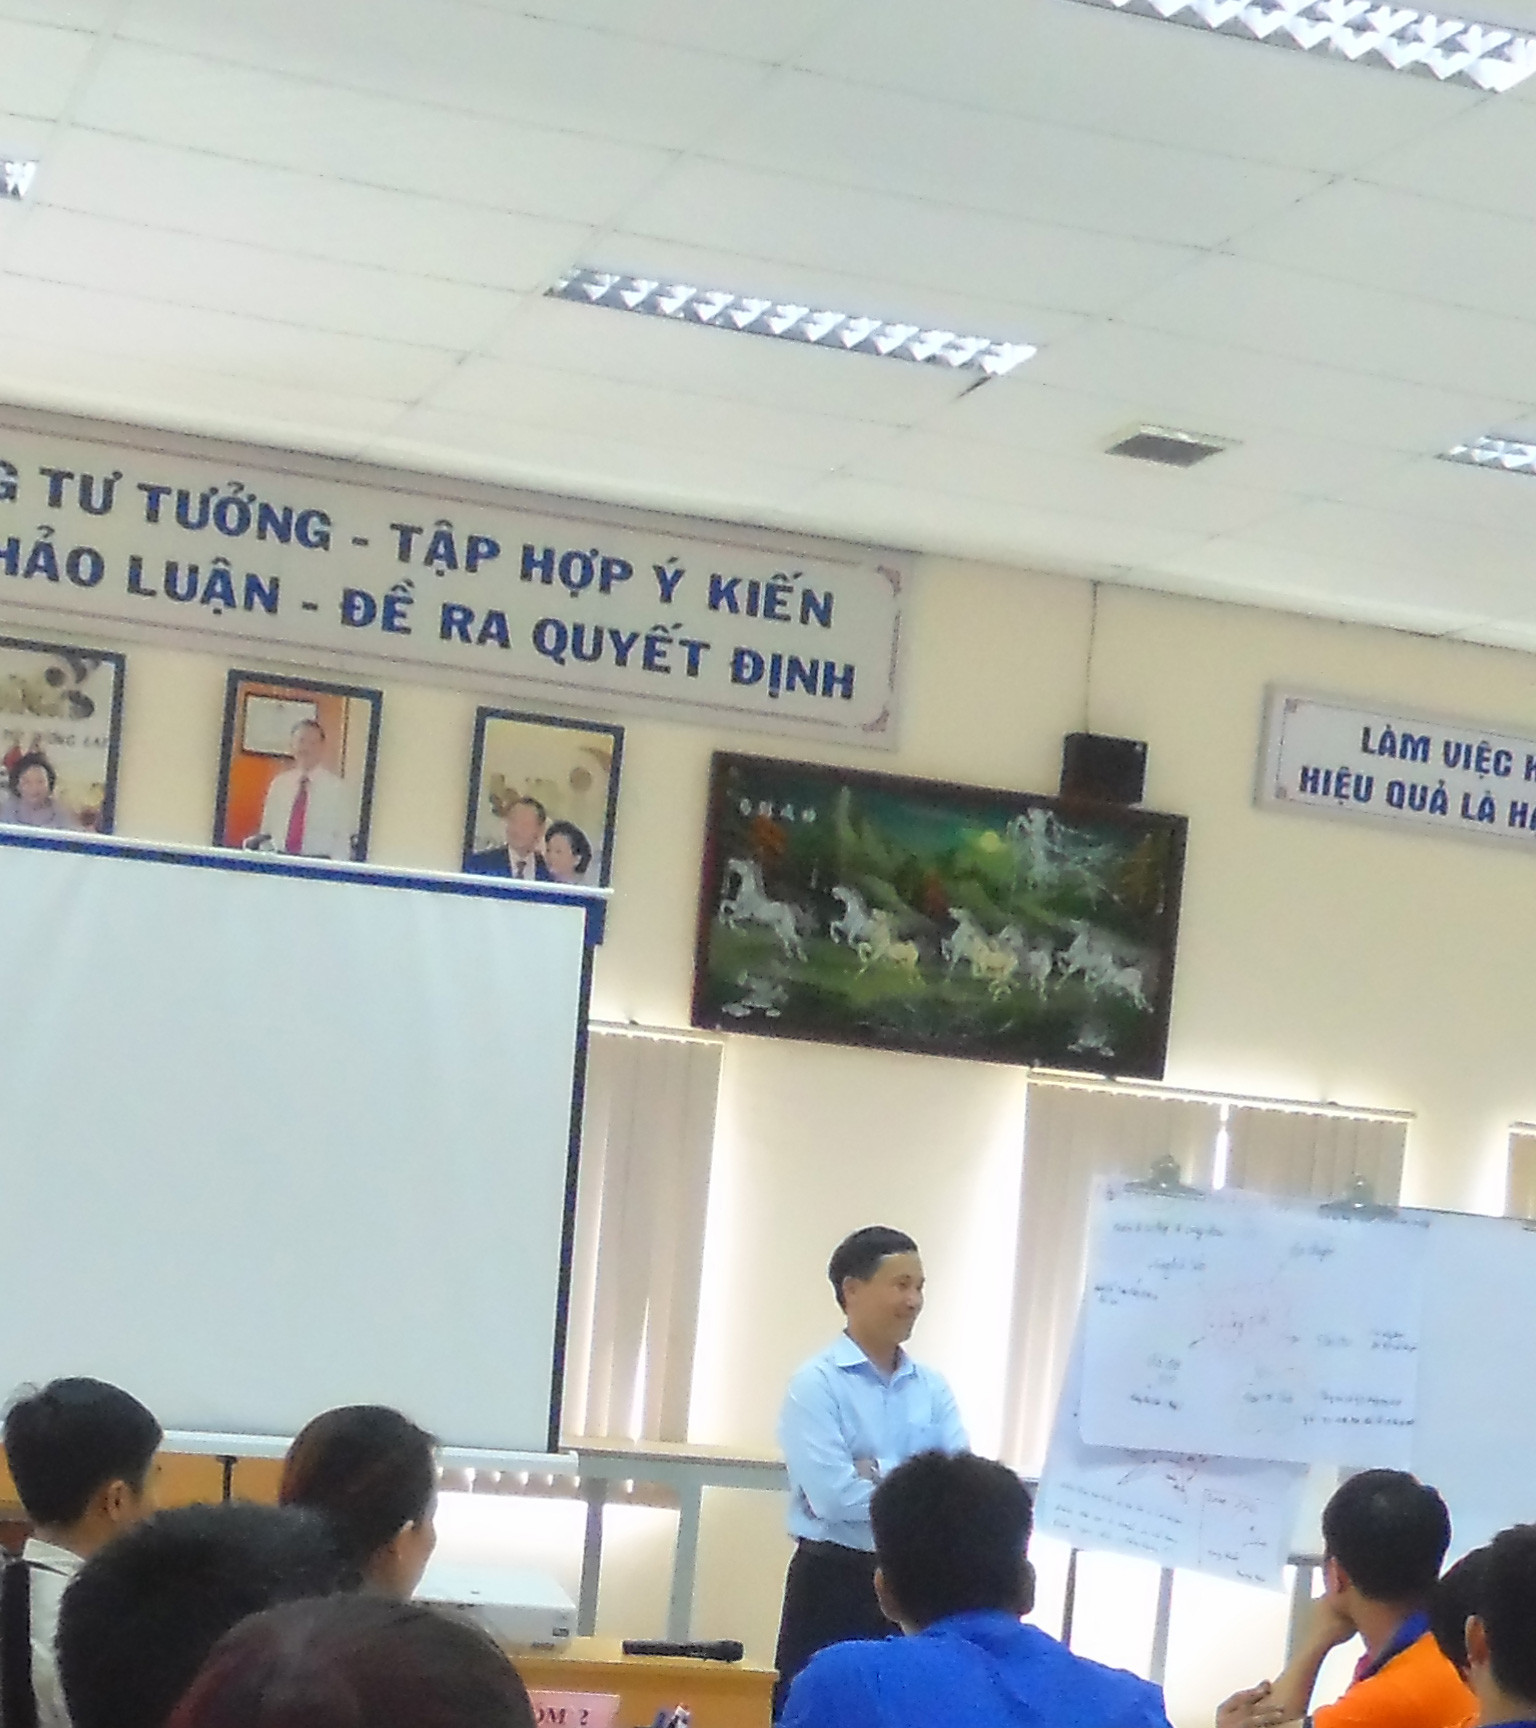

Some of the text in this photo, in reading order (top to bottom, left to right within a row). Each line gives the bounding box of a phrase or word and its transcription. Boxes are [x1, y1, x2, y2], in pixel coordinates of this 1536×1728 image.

[39, 467, 122, 516] TƯ
[138, 480, 331, 551] TƯỞNG
[390, 519, 501, 576] TẬP
[519, 544, 633, 598] HỢP
[653, 557, 685, 604] Ý
[708, 571, 834, 628] KIẾN
[126, 553, 280, 616] LUẬN
[339, 578, 415, 635] ĐỀ
[439, 601, 511, 650] RA
[532, 616, 711, 678] QUYẾT
[730, 646, 855, 700] ĐỊNH
[1361, 724, 1431, 764] LÀM
[1442, 739, 1512, 778] VIỆC
